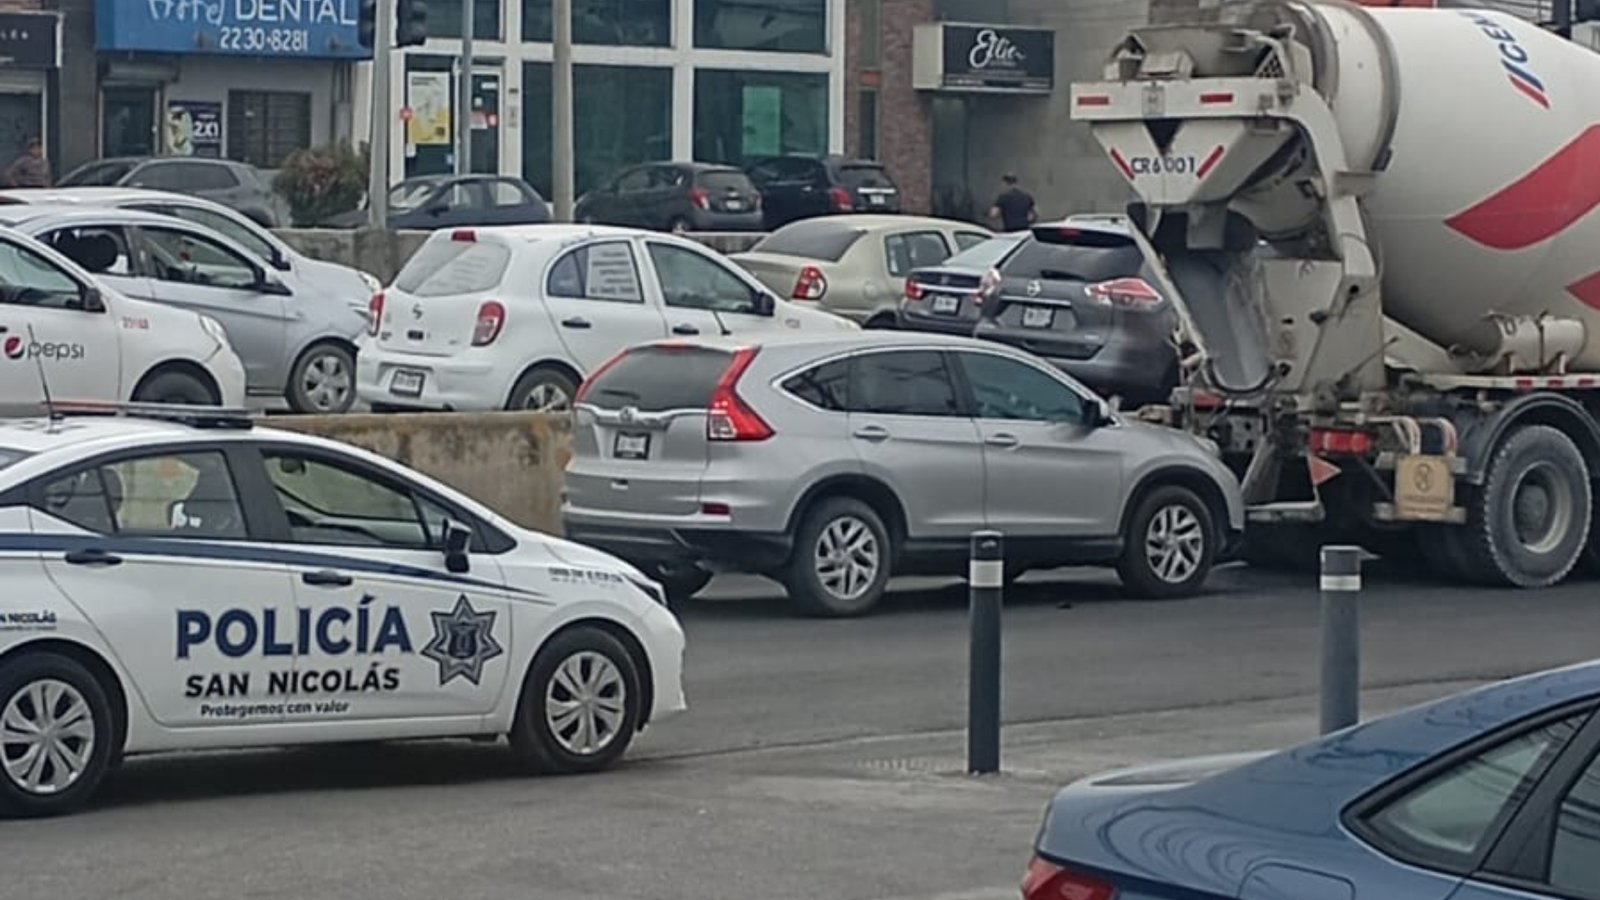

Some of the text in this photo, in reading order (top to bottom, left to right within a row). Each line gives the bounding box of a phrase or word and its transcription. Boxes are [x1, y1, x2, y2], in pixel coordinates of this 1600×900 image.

[236, 0, 357, 25] DENTAL
[27, 342, 85, 361] pepsi
[176, 594, 413, 660] POLICÍA
[185, 661, 400, 698] SAN NICOLÁS
[200, 702, 284, 719] Protegemos
[315, 700, 350, 714] valor
